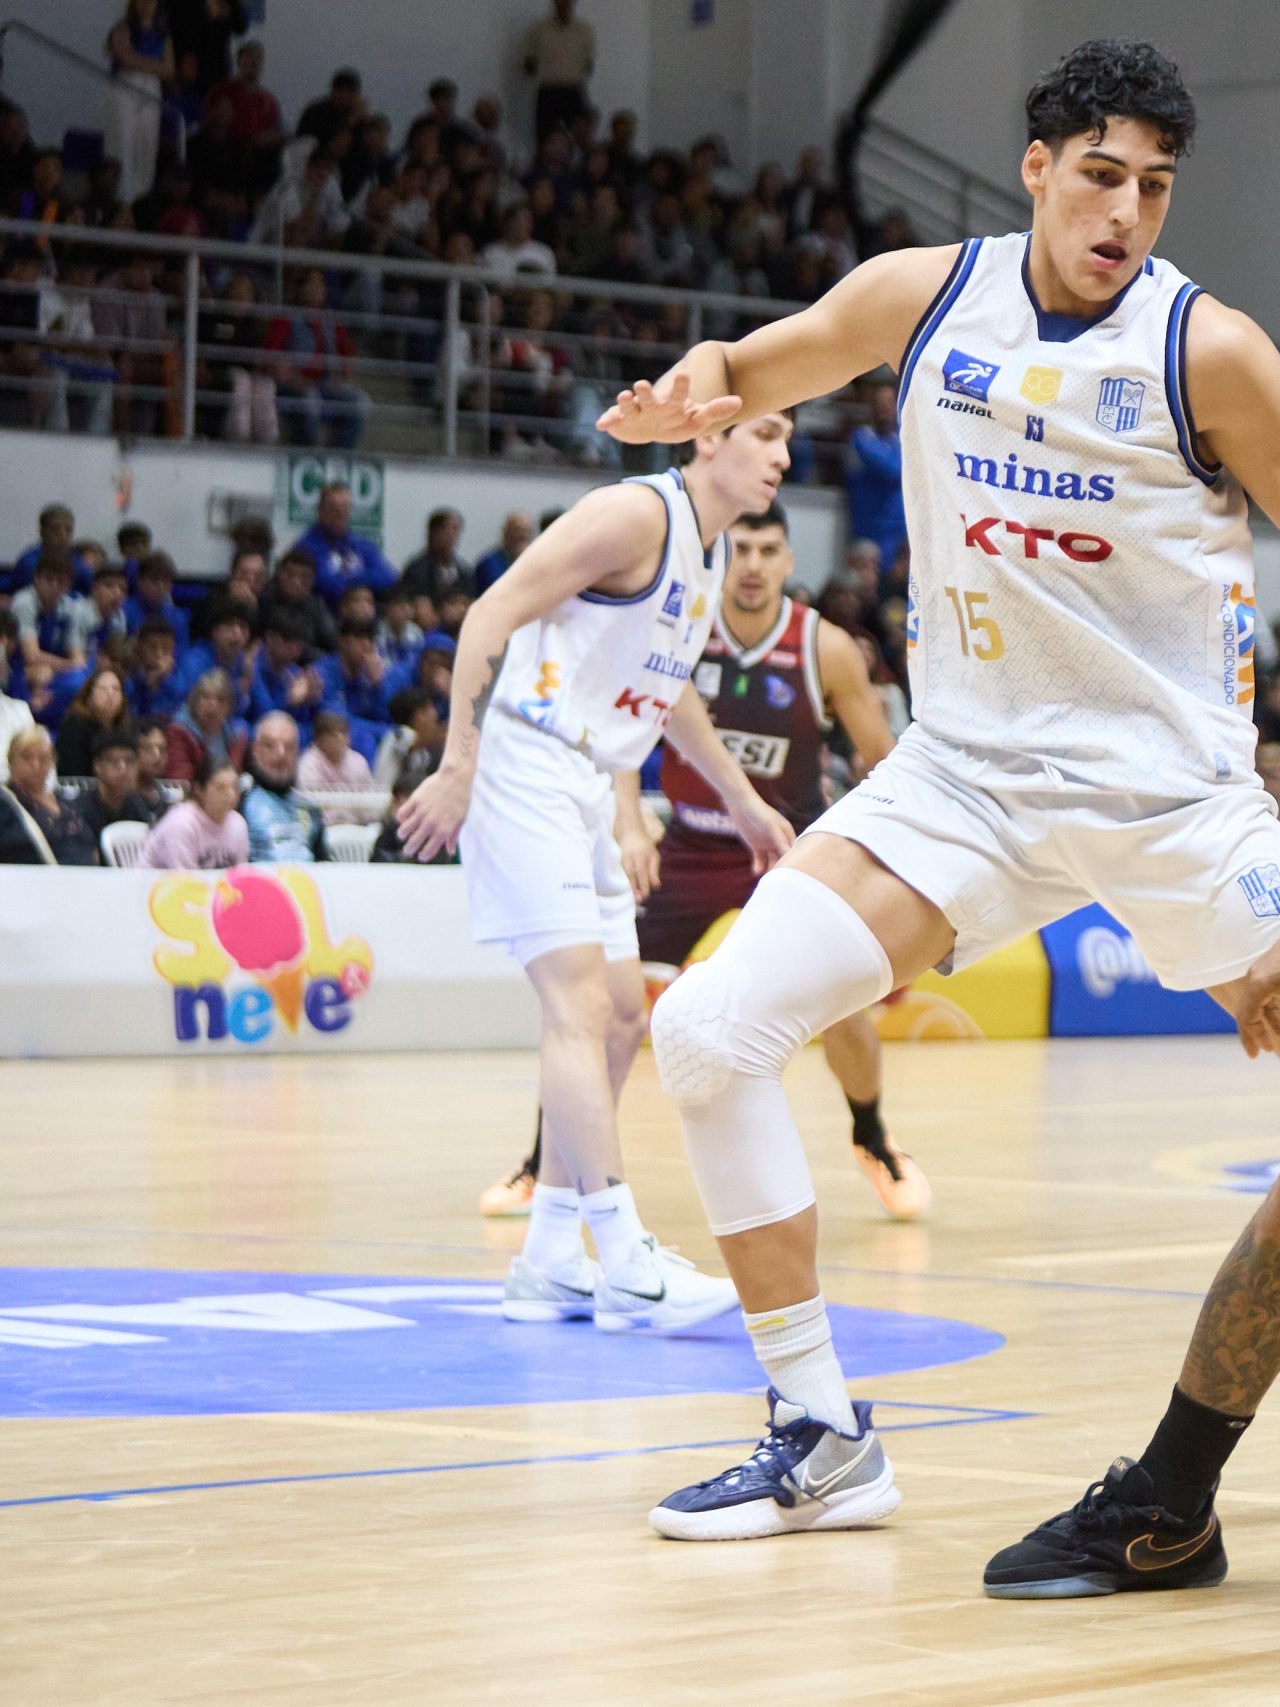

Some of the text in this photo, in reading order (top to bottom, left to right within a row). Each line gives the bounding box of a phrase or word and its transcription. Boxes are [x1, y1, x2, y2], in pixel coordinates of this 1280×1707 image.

[954, 452, 1116, 502] minas
[960, 513, 1114, 563] KTO
[943, 586, 1006, 662] 15
